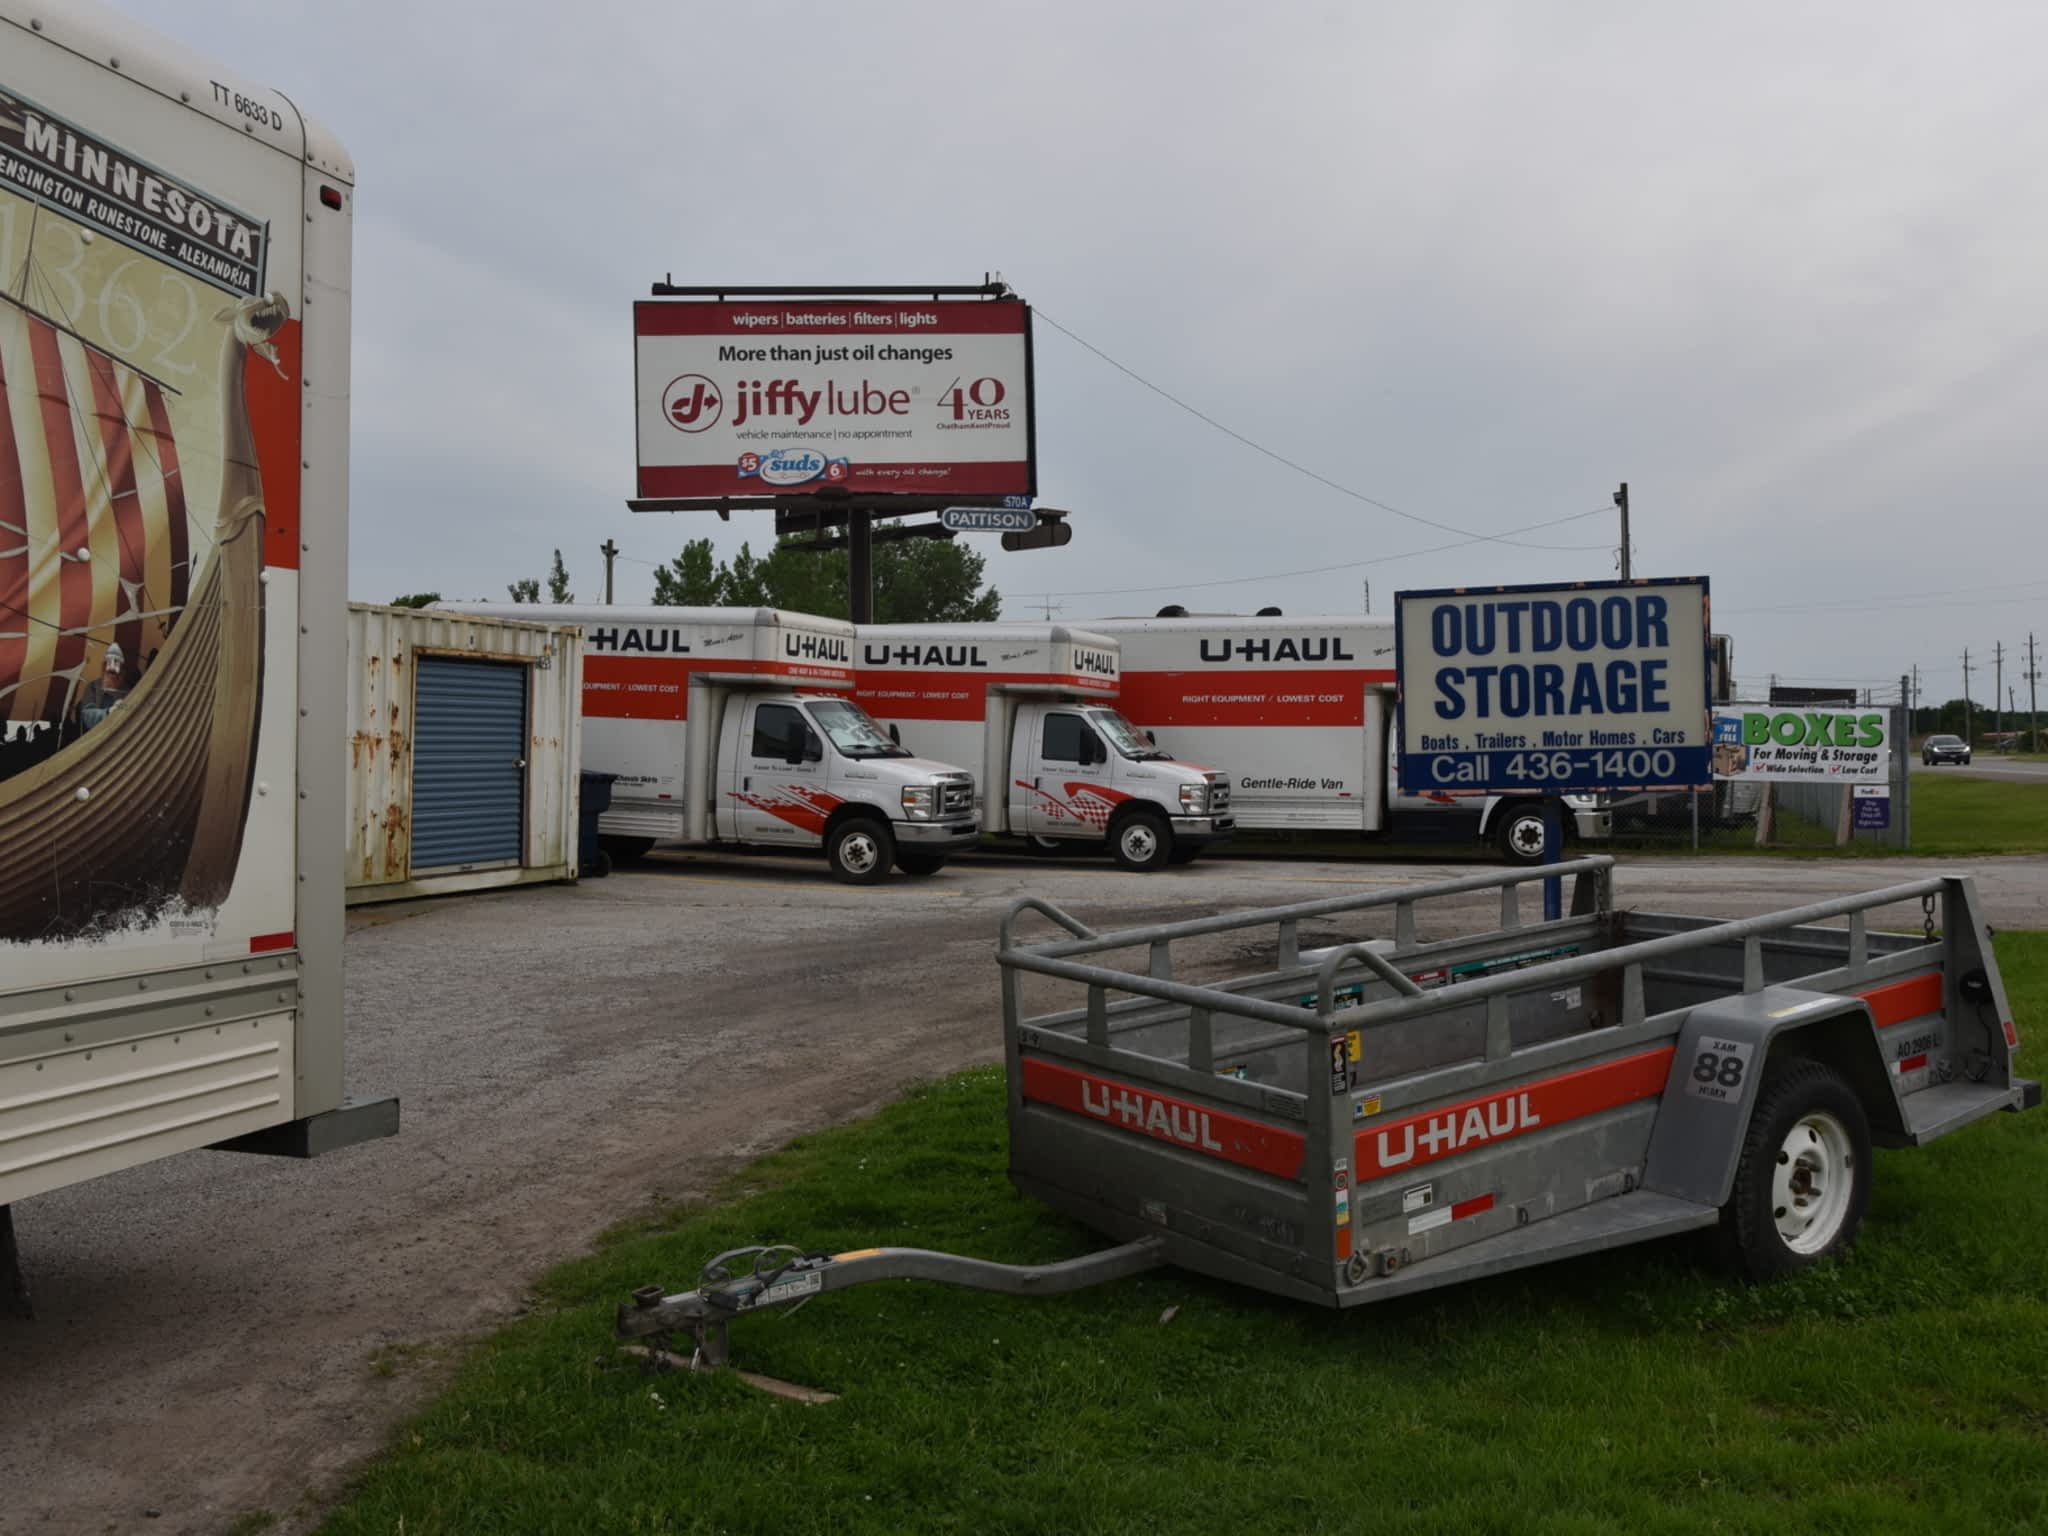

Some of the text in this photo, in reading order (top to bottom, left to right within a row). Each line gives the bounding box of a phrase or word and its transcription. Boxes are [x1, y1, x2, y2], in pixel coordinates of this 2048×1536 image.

[209, 79, 282, 131] TT 6633 D
[23, 113, 253, 259] MINNESOTA
[86, 197, 168, 251] RUNESTONE
[178, 242, 251, 289] ALEXANDRIA
[732, 311, 939, 328] wipers batteries filters lights
[718, 344, 953, 365] More than just oil changes
[732, 379, 911, 426] jiffy lube
[936, 375, 1006, 420] 40
[967, 408, 1010, 420] YEARS
[735, 430, 913, 441] vehicle maintenance no appointment
[770, 454, 821, 472] suds
[949, 511, 1029, 527] PATTISON
[1431, 595, 1669, 657] OUTDOOR
[1182, 694, 1345, 704] RIGHT EQUIPMENT LOWEST COST
[1434, 659, 1670, 720] STORAGE
[1421, 728, 1685, 750] Boats Trailers Motor Homes Cars
[1743, 712, 1884, 748] BOXES
[1431, 749, 1676, 783] Call 436-1400
[1753, 748, 1878, 764] For Moving & Storage
[1766, 764, 1878, 775] Wide Selection Low Cost
[1240, 777, 1343, 789] Gentle-Ride Van
